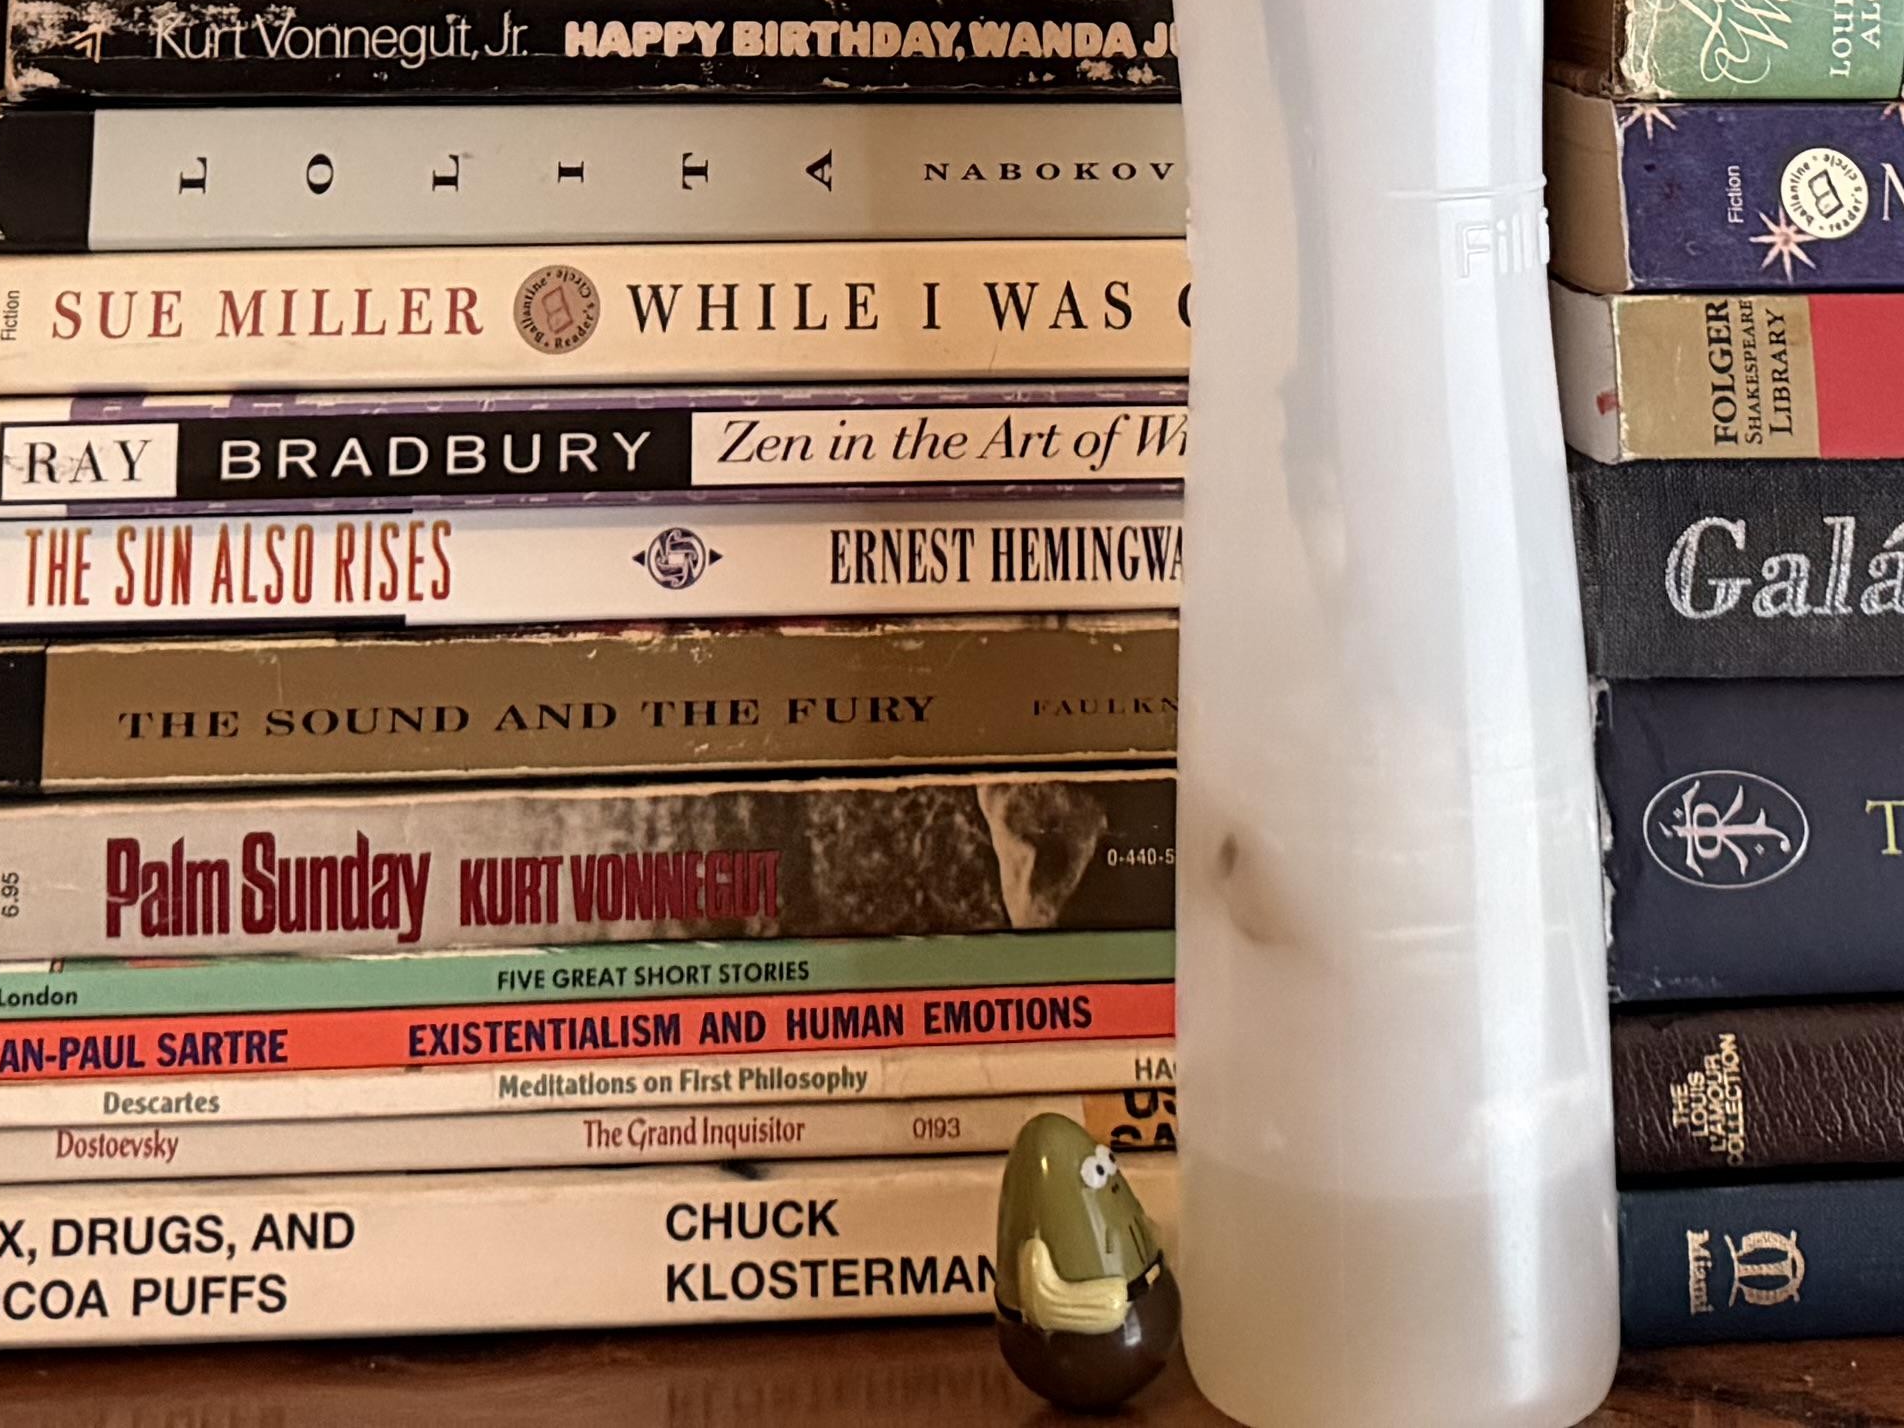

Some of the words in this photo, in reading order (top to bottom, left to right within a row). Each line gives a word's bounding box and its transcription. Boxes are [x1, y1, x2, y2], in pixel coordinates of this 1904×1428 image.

[0, 289, 21, 341] Fiction
[717, 418, 814, 464] Zen
[829, 419, 874, 461] in
[895, 418, 968, 462] the
[976, 417, 1060, 460] Art
[1072, 412, 1130, 471] of
[1, 872, 20, 918] 6.95
[105, 835, 230, 939] Palm
[241, 831, 432, 944] Sunday
[497, 969, 546, 991] FIVE
[552, 966, 627, 989] GREAT
[634, 964, 712, 986] SHORT
[719, 960, 809, 984] STORIES
[103, 1091, 221, 1115] Descartes
[1670, 1082, 1689, 1130] THE
[1691, 1071, 1710, 1138] LOUIS
[1708, 1054, 1729, 1153] L'AMOUR
[1717, 1033, 1744, 1168] COLLECTION
[55, 1130, 178, 1163] Dostoevsky
[583, 1119, 623, 1150] The
[627, 1117, 697, 1152] Grand
[702, 1115, 806, 1146] Inquisitor
[913, 1116, 961, 1139] 0193
